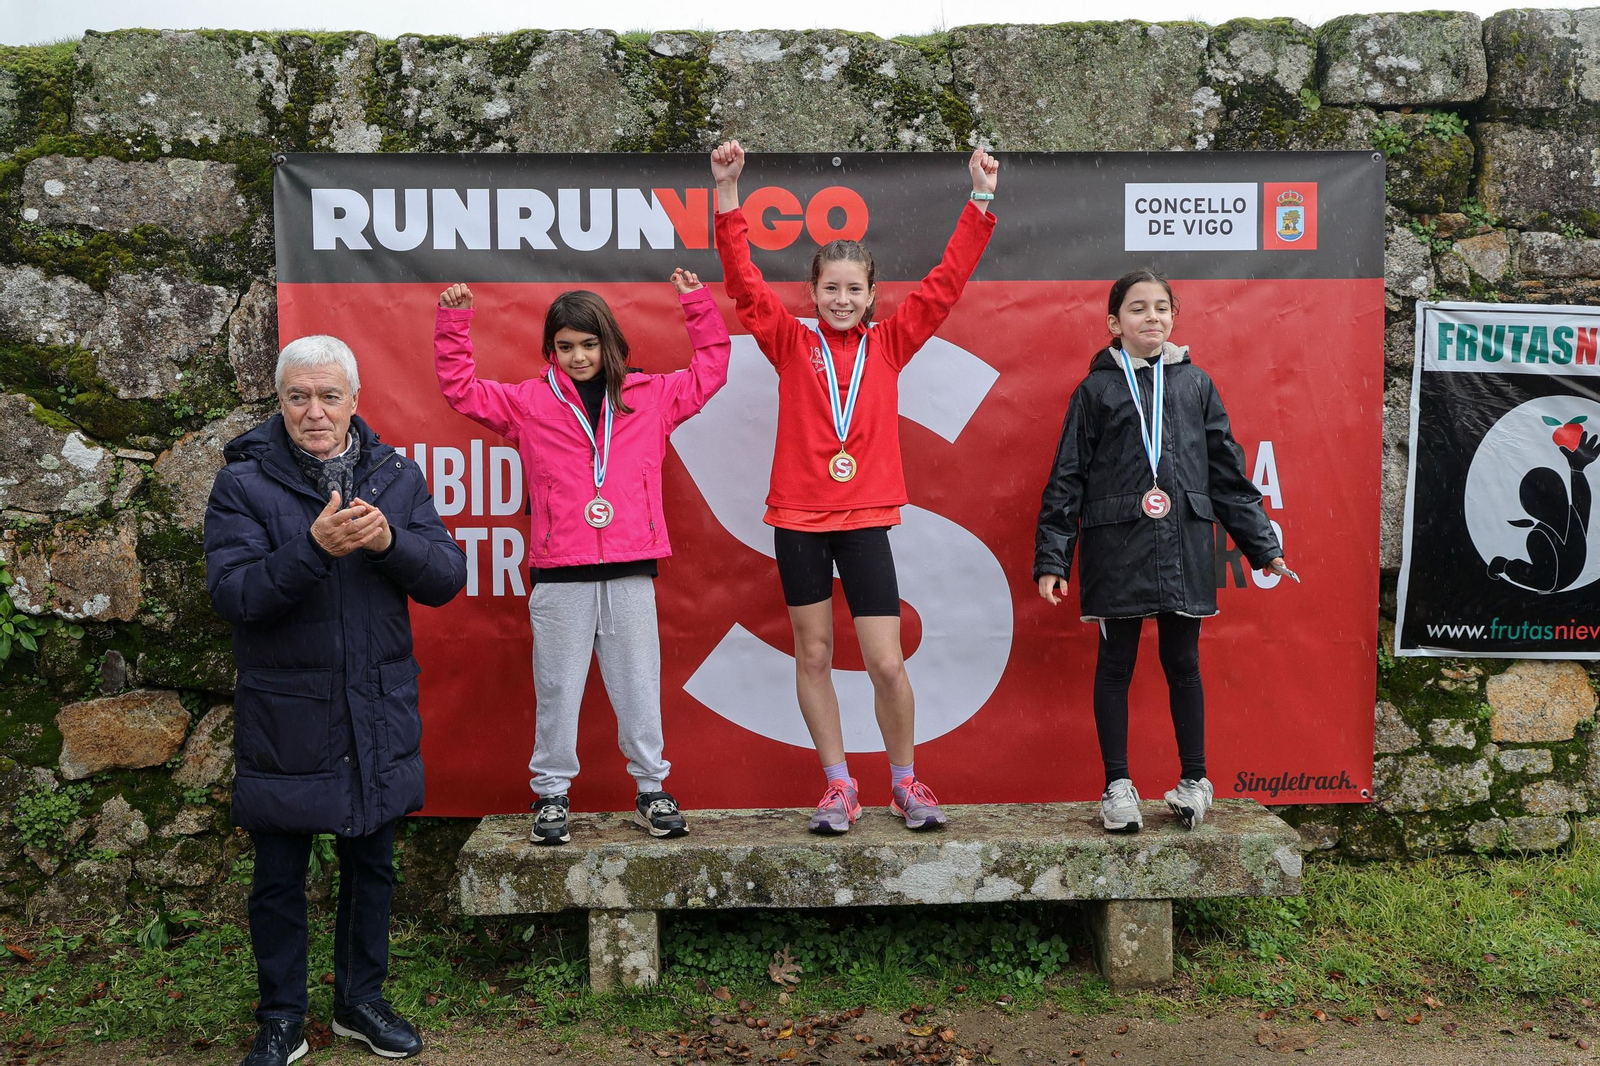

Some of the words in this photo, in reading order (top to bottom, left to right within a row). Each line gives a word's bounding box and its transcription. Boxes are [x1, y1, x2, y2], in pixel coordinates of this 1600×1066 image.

[1134, 197, 1247, 214] CONCELLO
[1148, 219, 1175, 235] DE
[1183, 219, 1233, 235] VIGO
